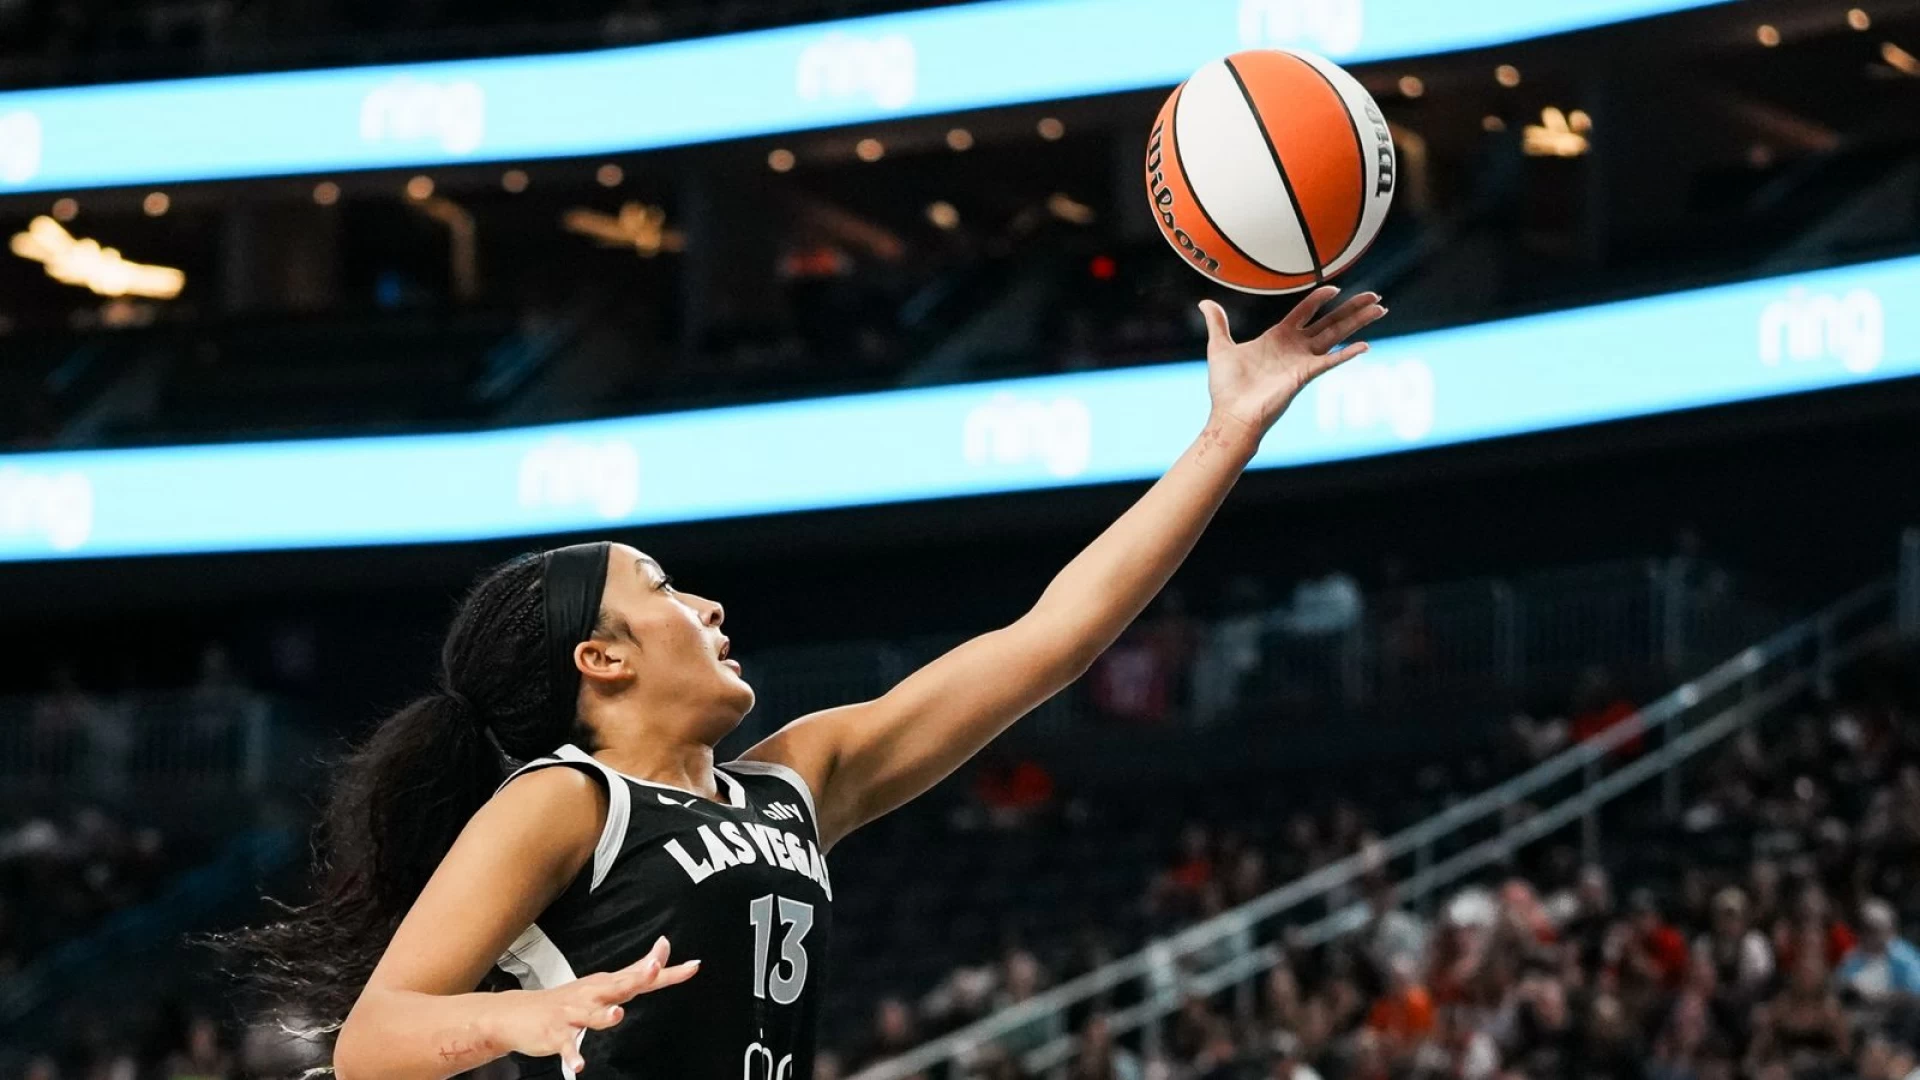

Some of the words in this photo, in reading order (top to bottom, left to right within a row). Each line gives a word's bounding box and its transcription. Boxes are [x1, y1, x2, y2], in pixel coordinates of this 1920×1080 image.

[1237, 0, 1363, 55] ring
[797, 33, 916, 108] ring
[360, 77, 485, 153] ring
[1147, 119, 1221, 273] Wilson
[1760, 286, 1883, 373] ring
[963, 392, 1092, 477] ring
[0, 468, 93, 550] ing
[518, 436, 640, 519] ring
[762, 801, 804, 823] ally
[663, 821, 757, 884] LAS
[741, 821, 832, 902] VEGA
[750, 893, 814, 1005] 13
